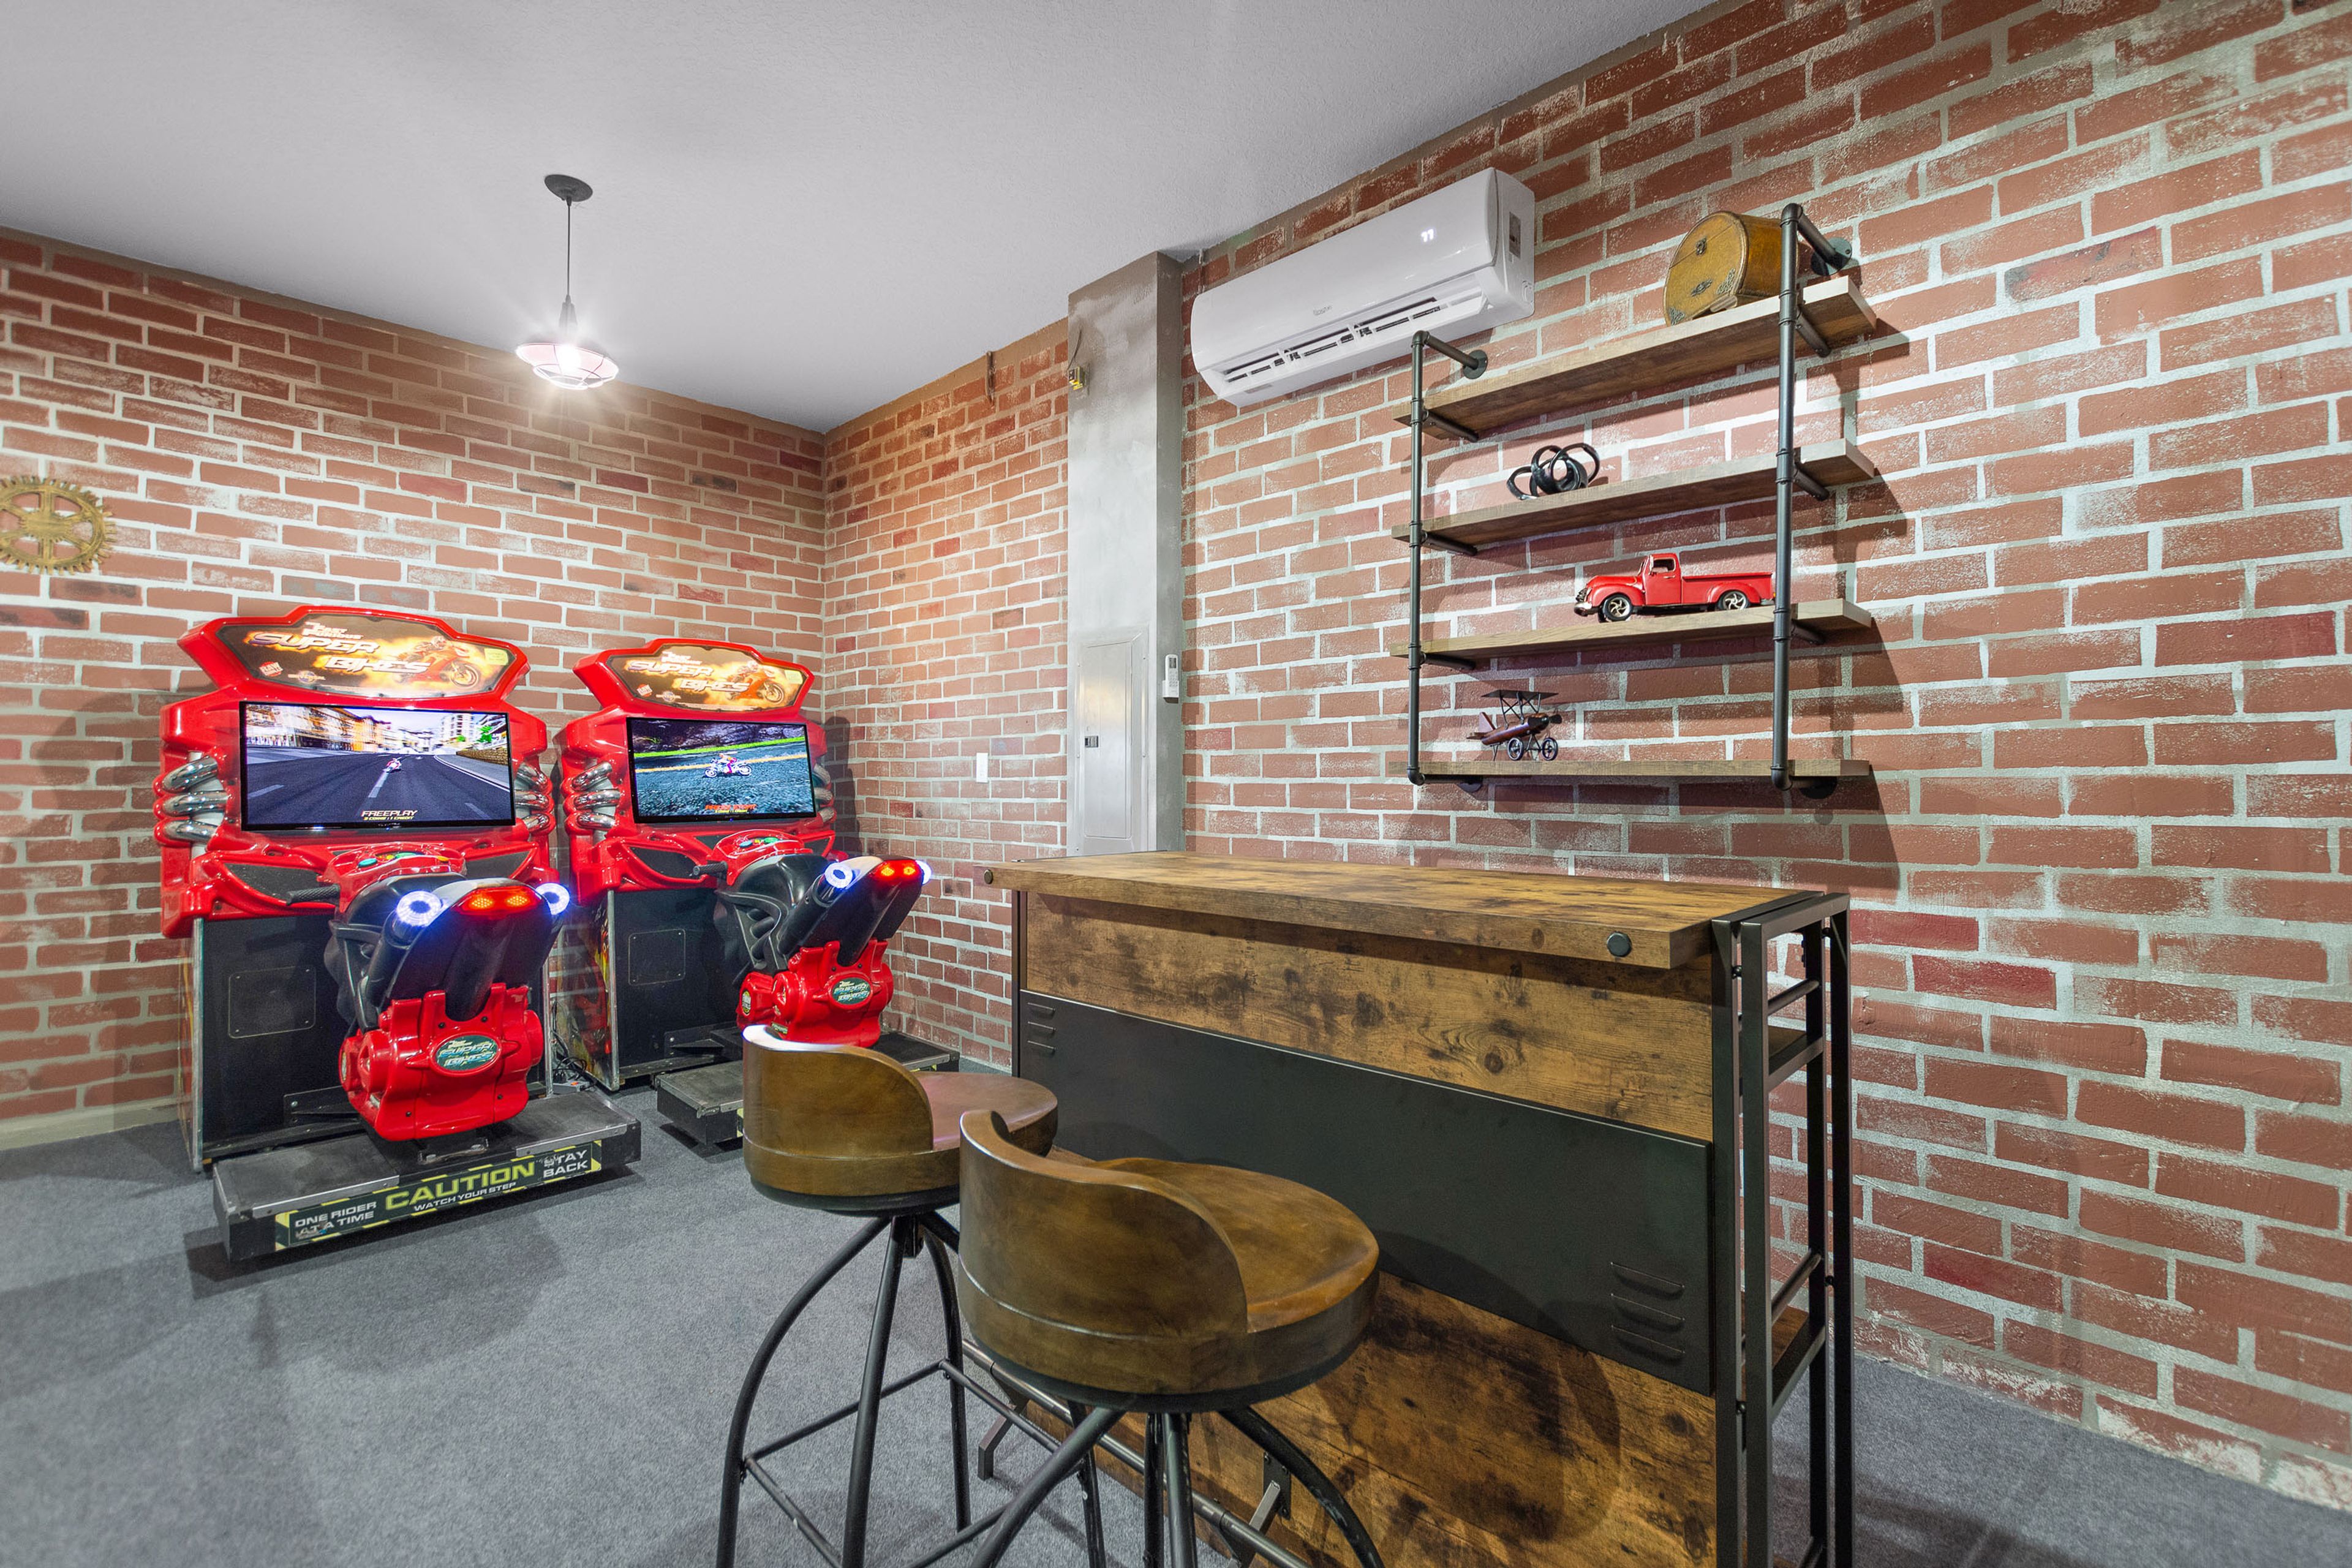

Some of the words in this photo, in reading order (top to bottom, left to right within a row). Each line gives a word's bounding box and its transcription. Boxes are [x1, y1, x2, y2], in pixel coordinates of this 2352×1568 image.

[248, 632, 382, 654] SUPER
[325, 655, 432, 673] BIKES
[627, 660, 714, 676] SUPER
[680, 679, 750, 693] BIKES
[543, 1150, 587, 1167] STAY
[543, 1160, 588, 1178] BACK
[385, 1162, 535, 1211] CAUTION
[414, 1196, 456, 1212] WATCH
[458, 1187, 488, 1200] YOUR
[489, 1182, 516, 1194] STEP
[295, 1213, 328, 1227] ONE
[331, 1201, 377, 1219] RIDER
[337, 1211, 375, 1226] TIME
